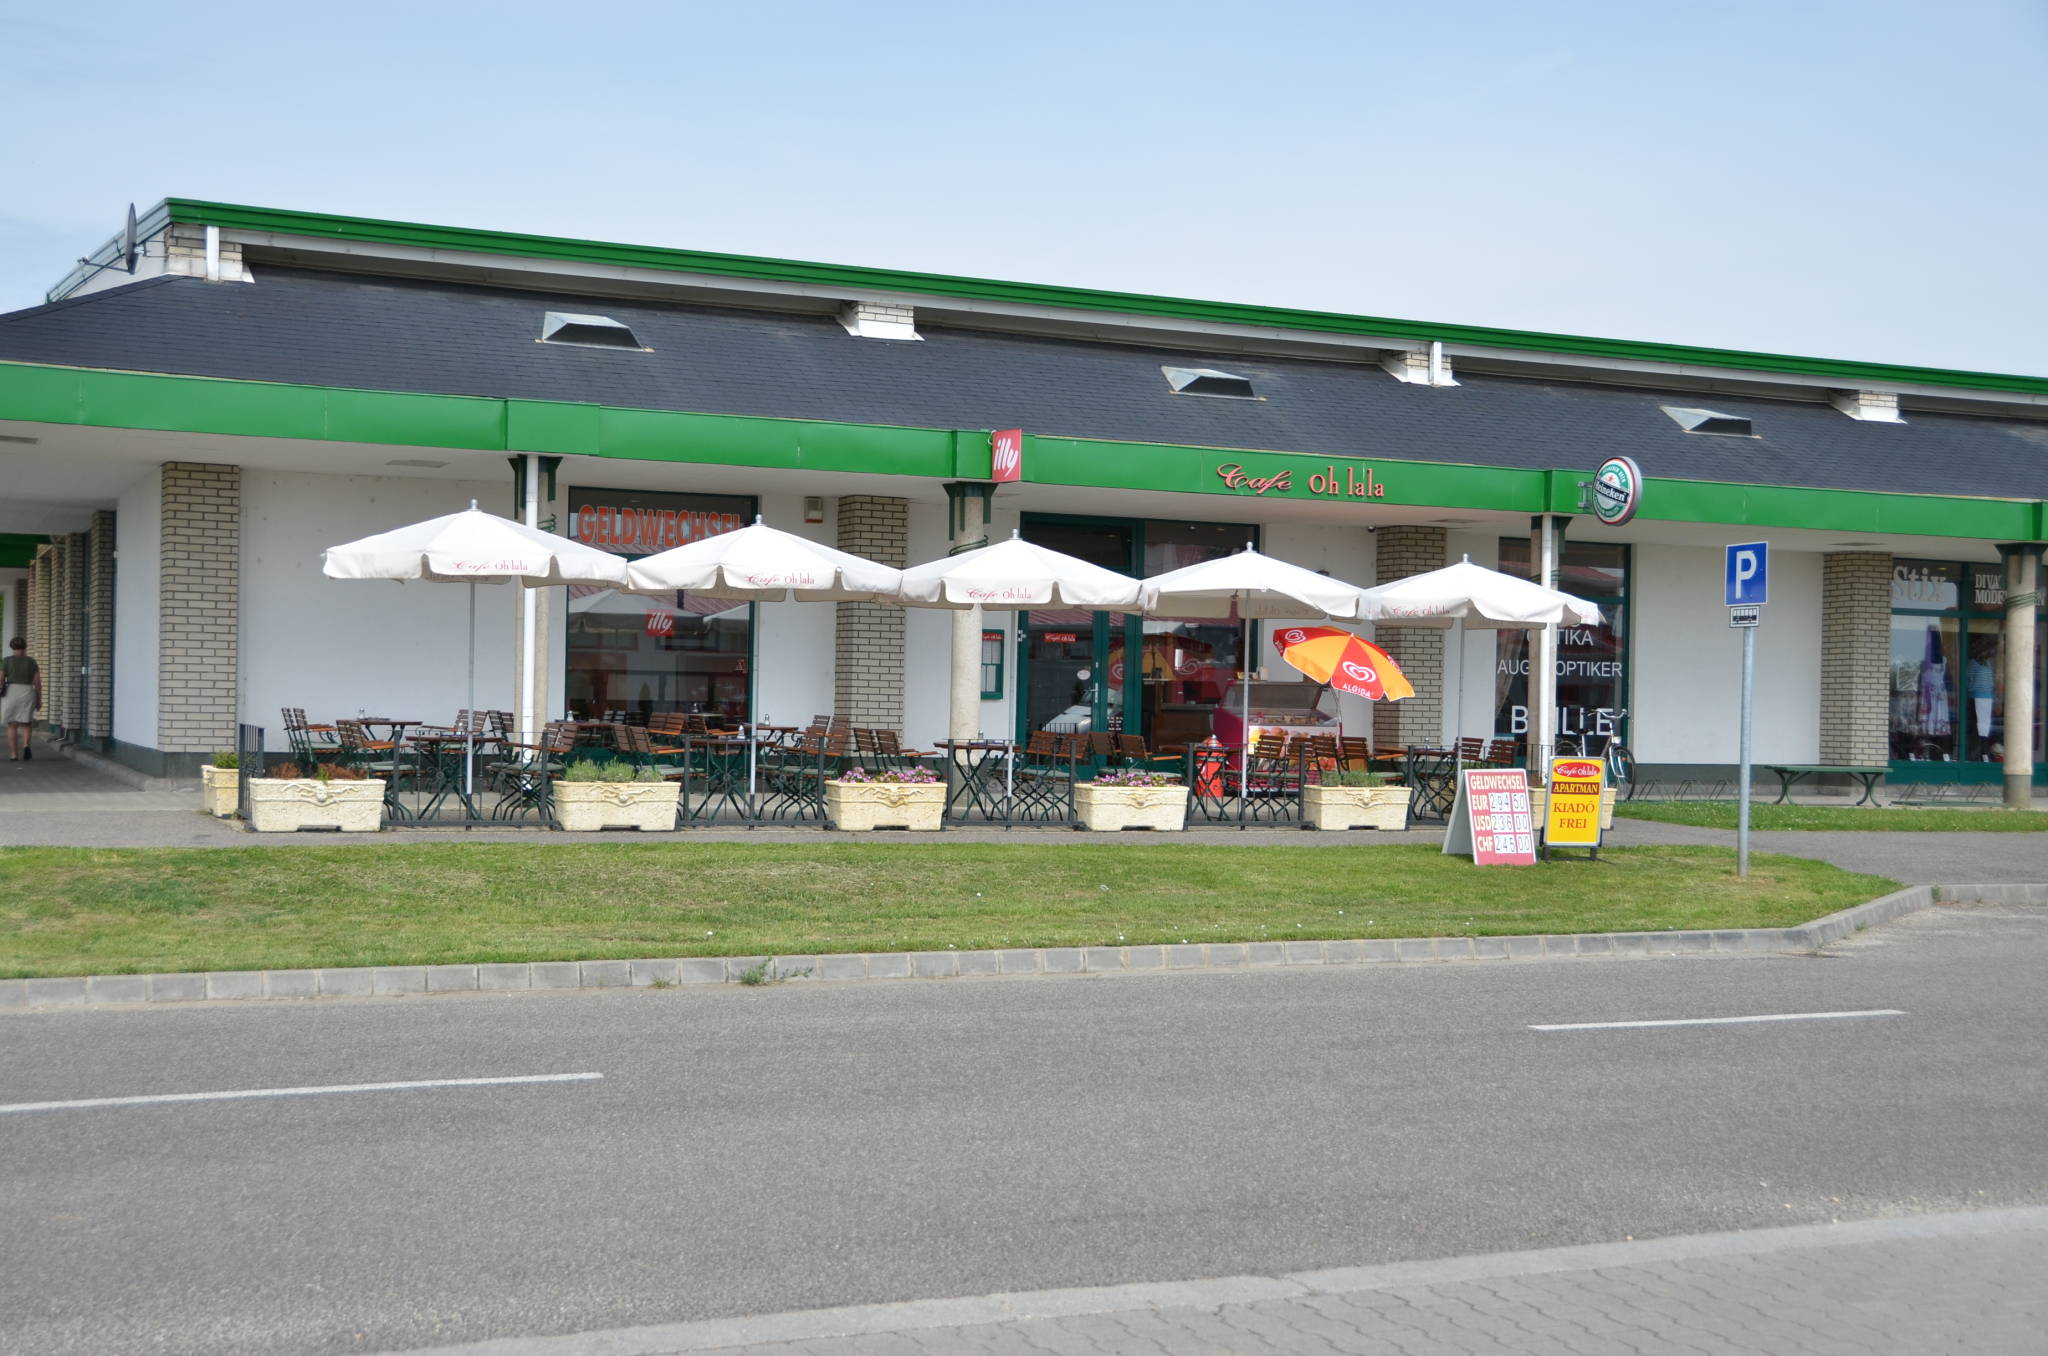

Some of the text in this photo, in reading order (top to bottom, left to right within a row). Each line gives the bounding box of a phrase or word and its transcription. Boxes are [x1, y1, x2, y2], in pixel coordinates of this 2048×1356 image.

[994, 437, 1019, 478] illy
[1309, 465, 1339, 494] Oh
[1347, 466, 1385, 497] lala
[1735, 550, 1757, 599] P
[1893, 566, 1946, 601] Stix
[647, 611, 672, 634] illy
[1527, 628, 1594, 646] TIKA
[1497, 659, 1623, 677] AUGOPTIKER
[1511, 705, 1614, 736] BILLE
[1471, 775, 1524, 790] GELDWECHSEL
[1554, 783, 1598, 793] APARTMAN
[1472, 794, 1489, 810] EUR
[1553, 800, 1595, 813] KIADÓ
[1474, 815, 1491, 831] USD
[1559, 818, 1587, 829] FREI
[1477, 836, 1493, 852] CHF
